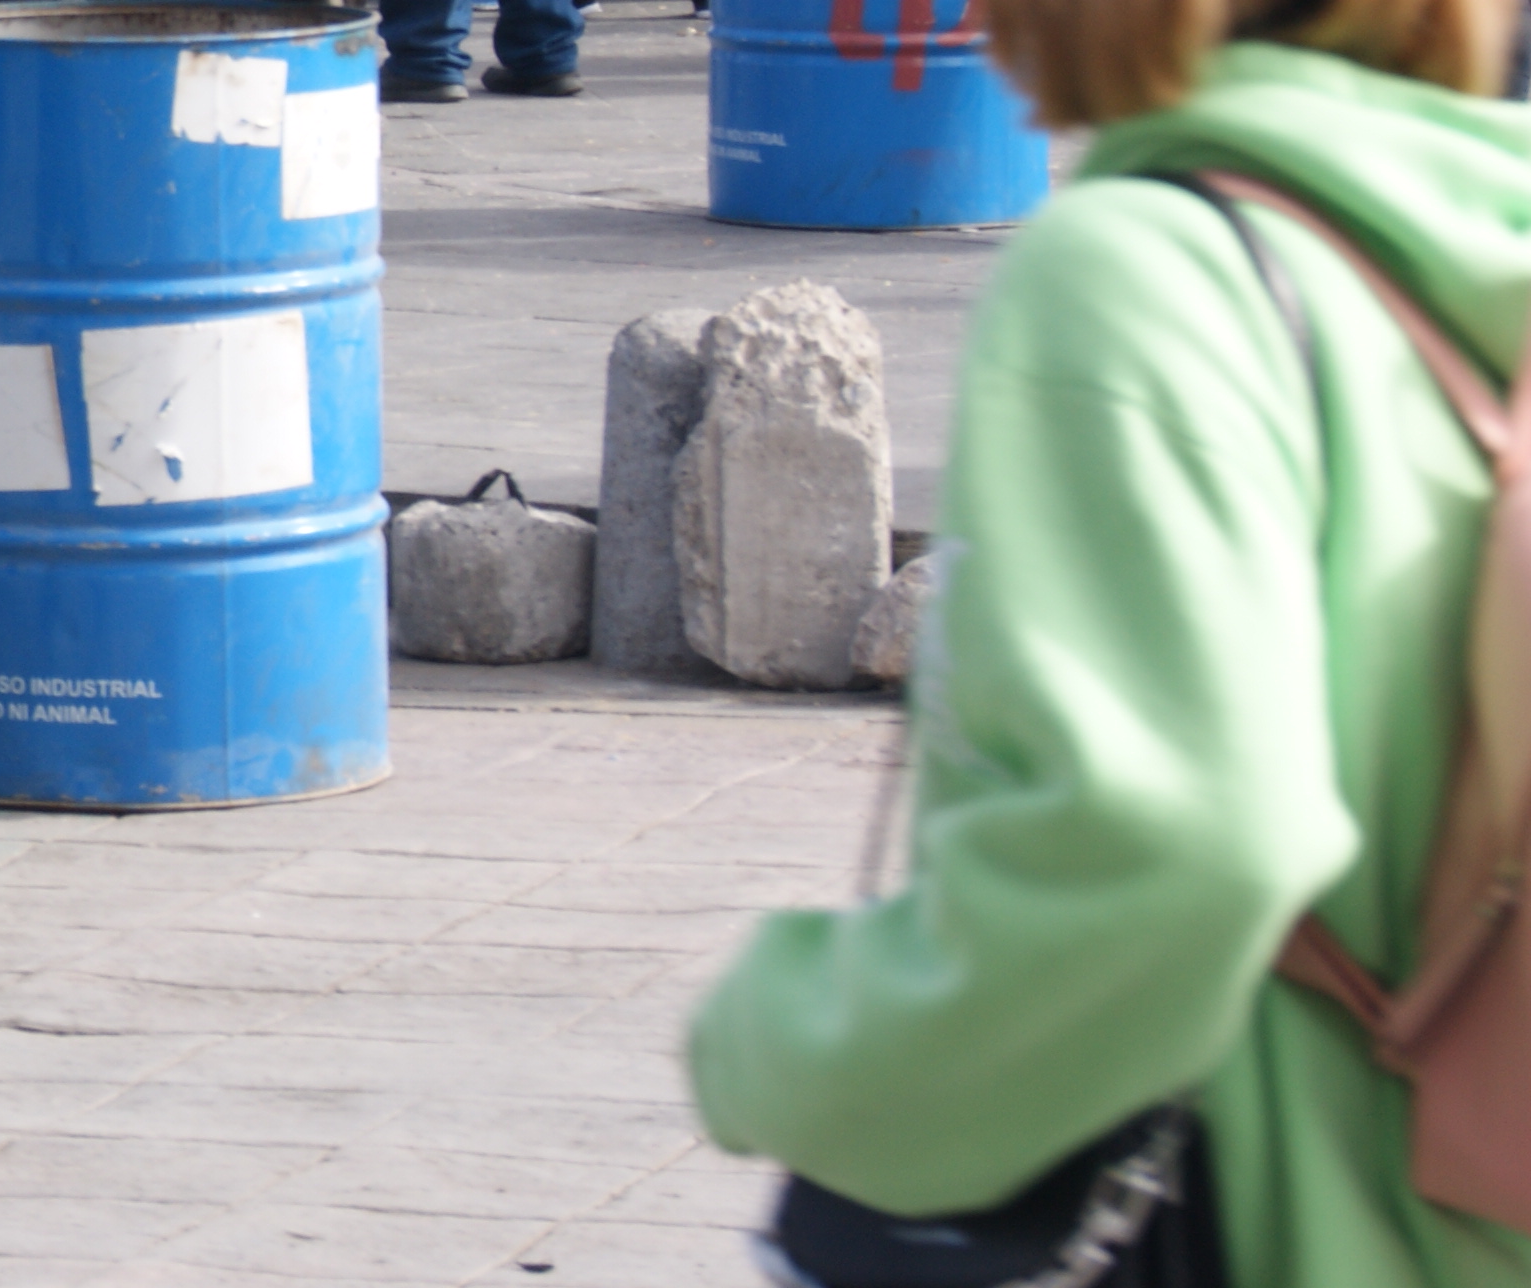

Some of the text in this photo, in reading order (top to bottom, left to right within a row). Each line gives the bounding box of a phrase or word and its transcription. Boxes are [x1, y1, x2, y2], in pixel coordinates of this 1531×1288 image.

[30, 677, 163, 699] INDUSTRIAL
[7, 702, 29, 721] NI
[33, 704, 117, 725] ANIMAL
